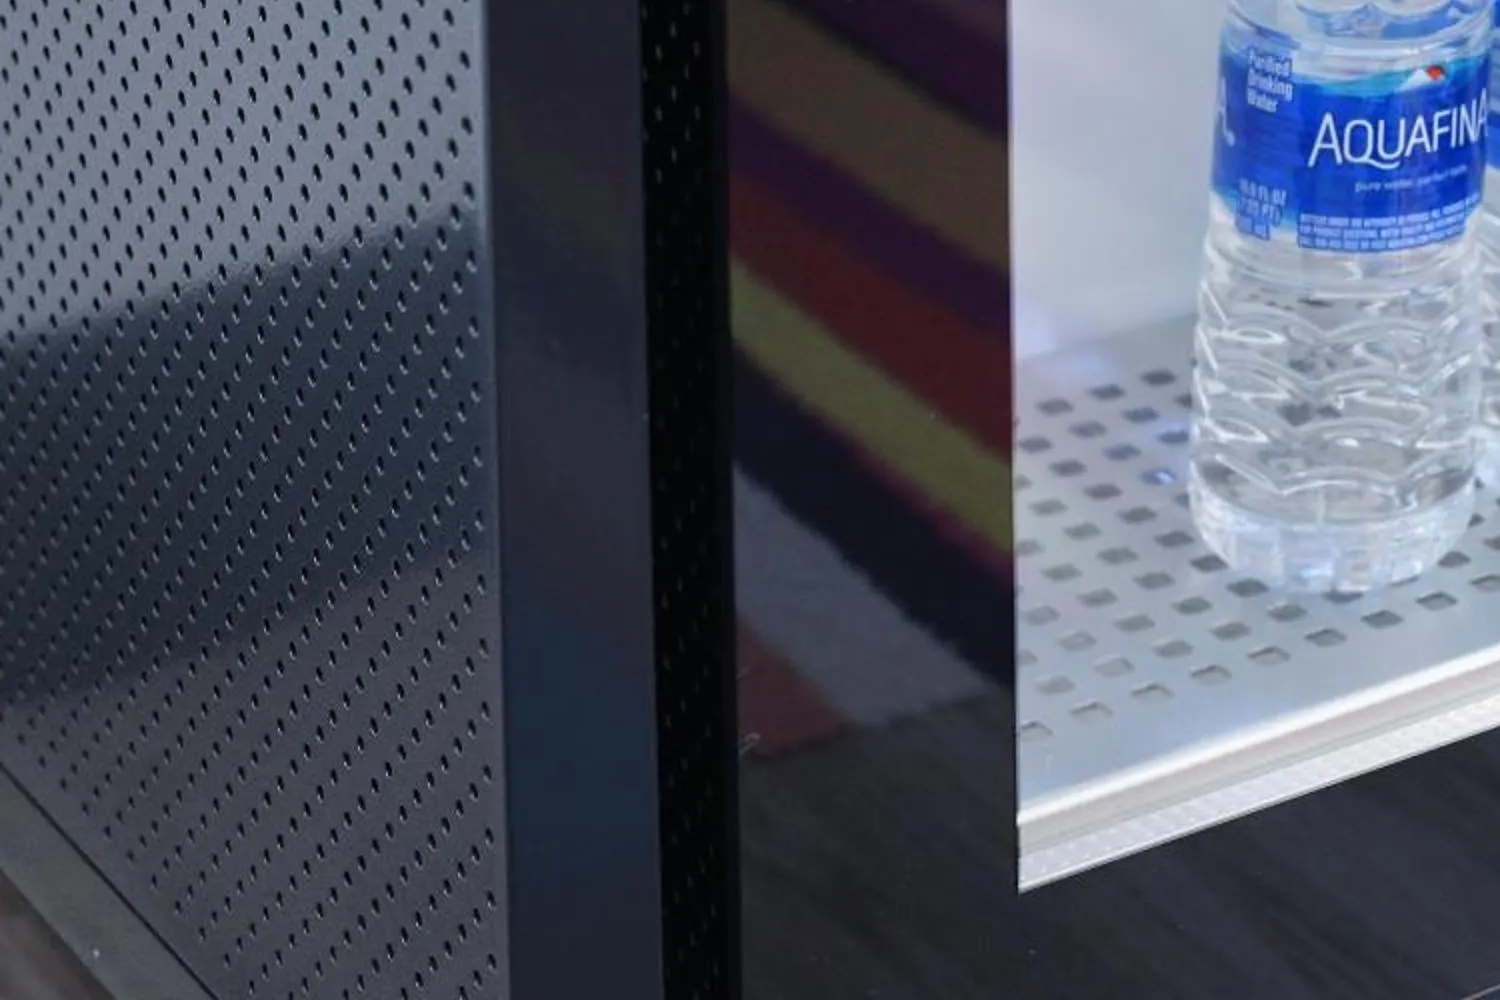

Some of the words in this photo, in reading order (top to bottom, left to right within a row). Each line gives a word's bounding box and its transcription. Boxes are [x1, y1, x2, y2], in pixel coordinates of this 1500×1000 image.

[1247, 48, 1292, 77] Purified
[1247, 67, 1294, 102] Drinking
[1247, 87, 1279, 114] Water
[1307, 87, 1488, 171] AQUAFINA
